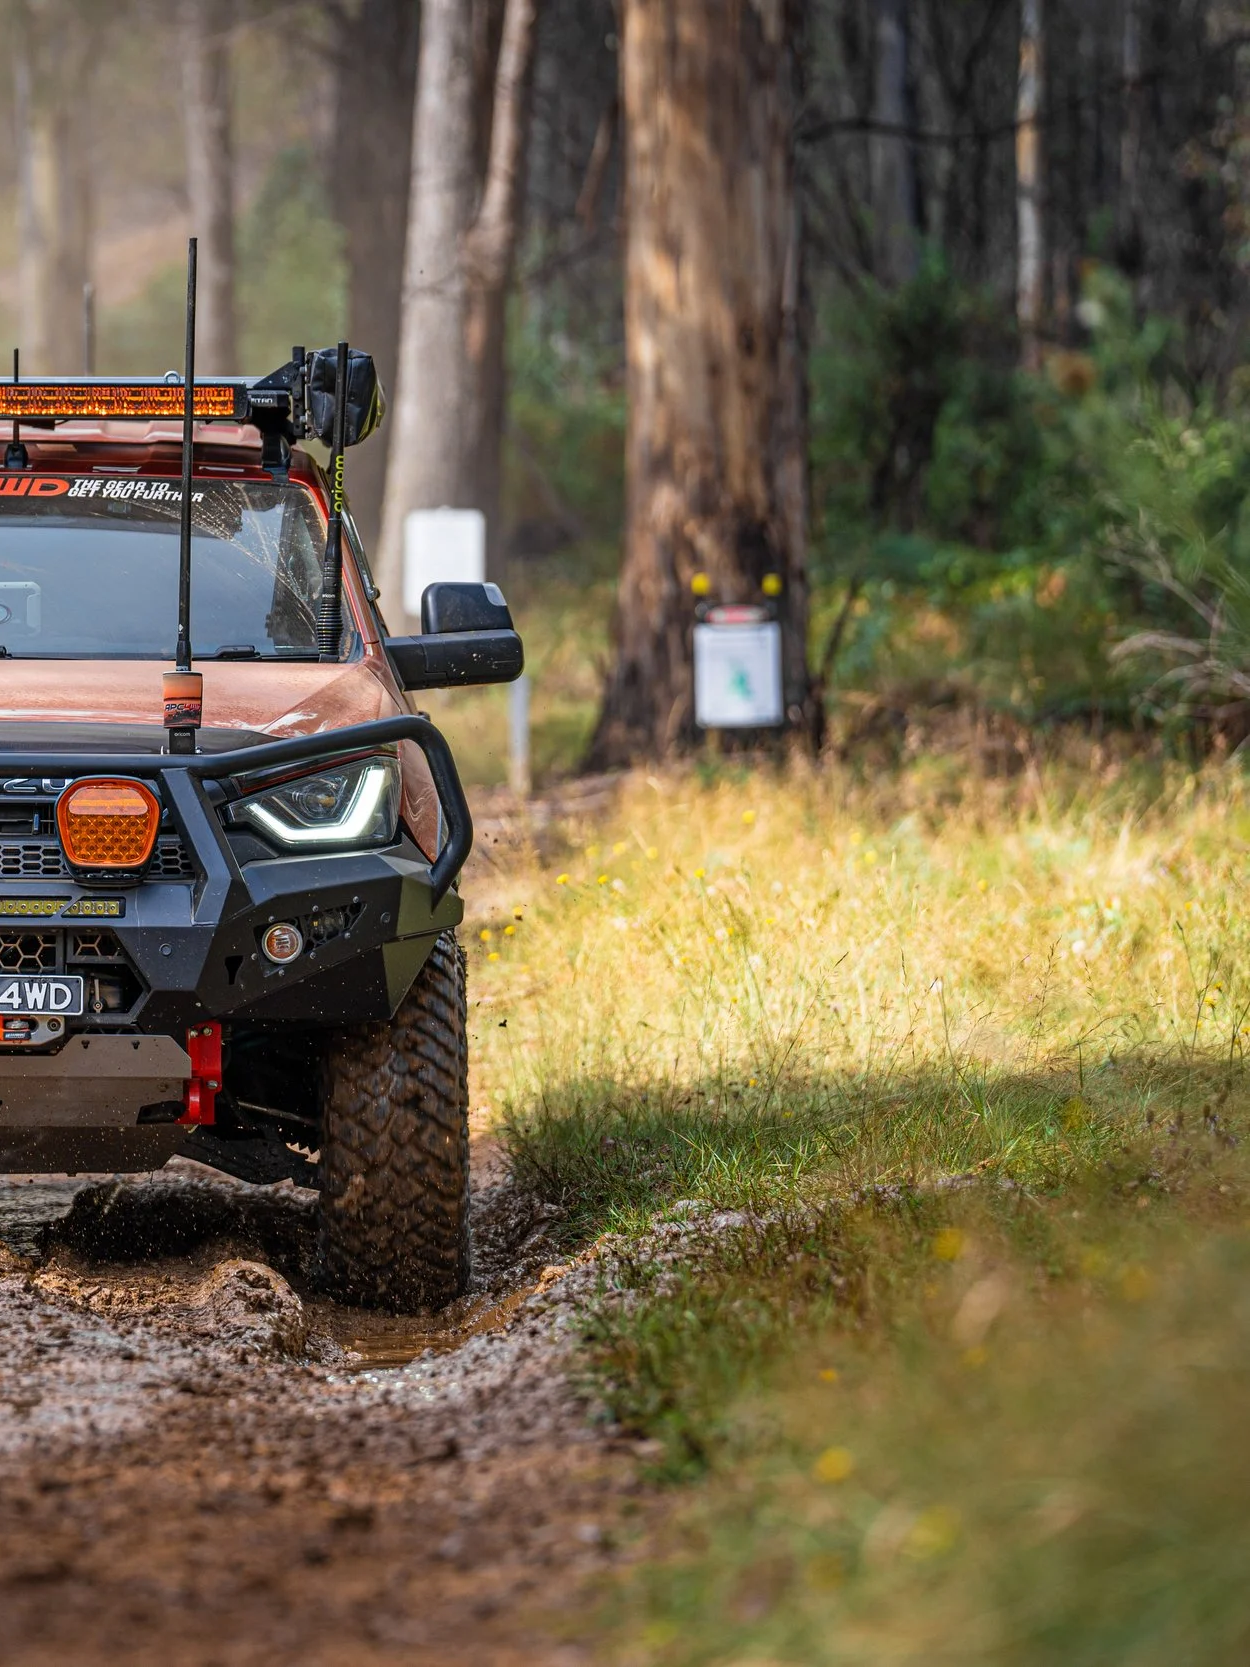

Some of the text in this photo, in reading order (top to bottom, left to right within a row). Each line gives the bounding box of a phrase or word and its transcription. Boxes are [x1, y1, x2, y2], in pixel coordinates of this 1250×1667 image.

[73, 479, 170, 492] THE GEAR TO
[331, 455, 345, 513] oricom
[67, 488, 204, 502] GET YOU FURTHR
